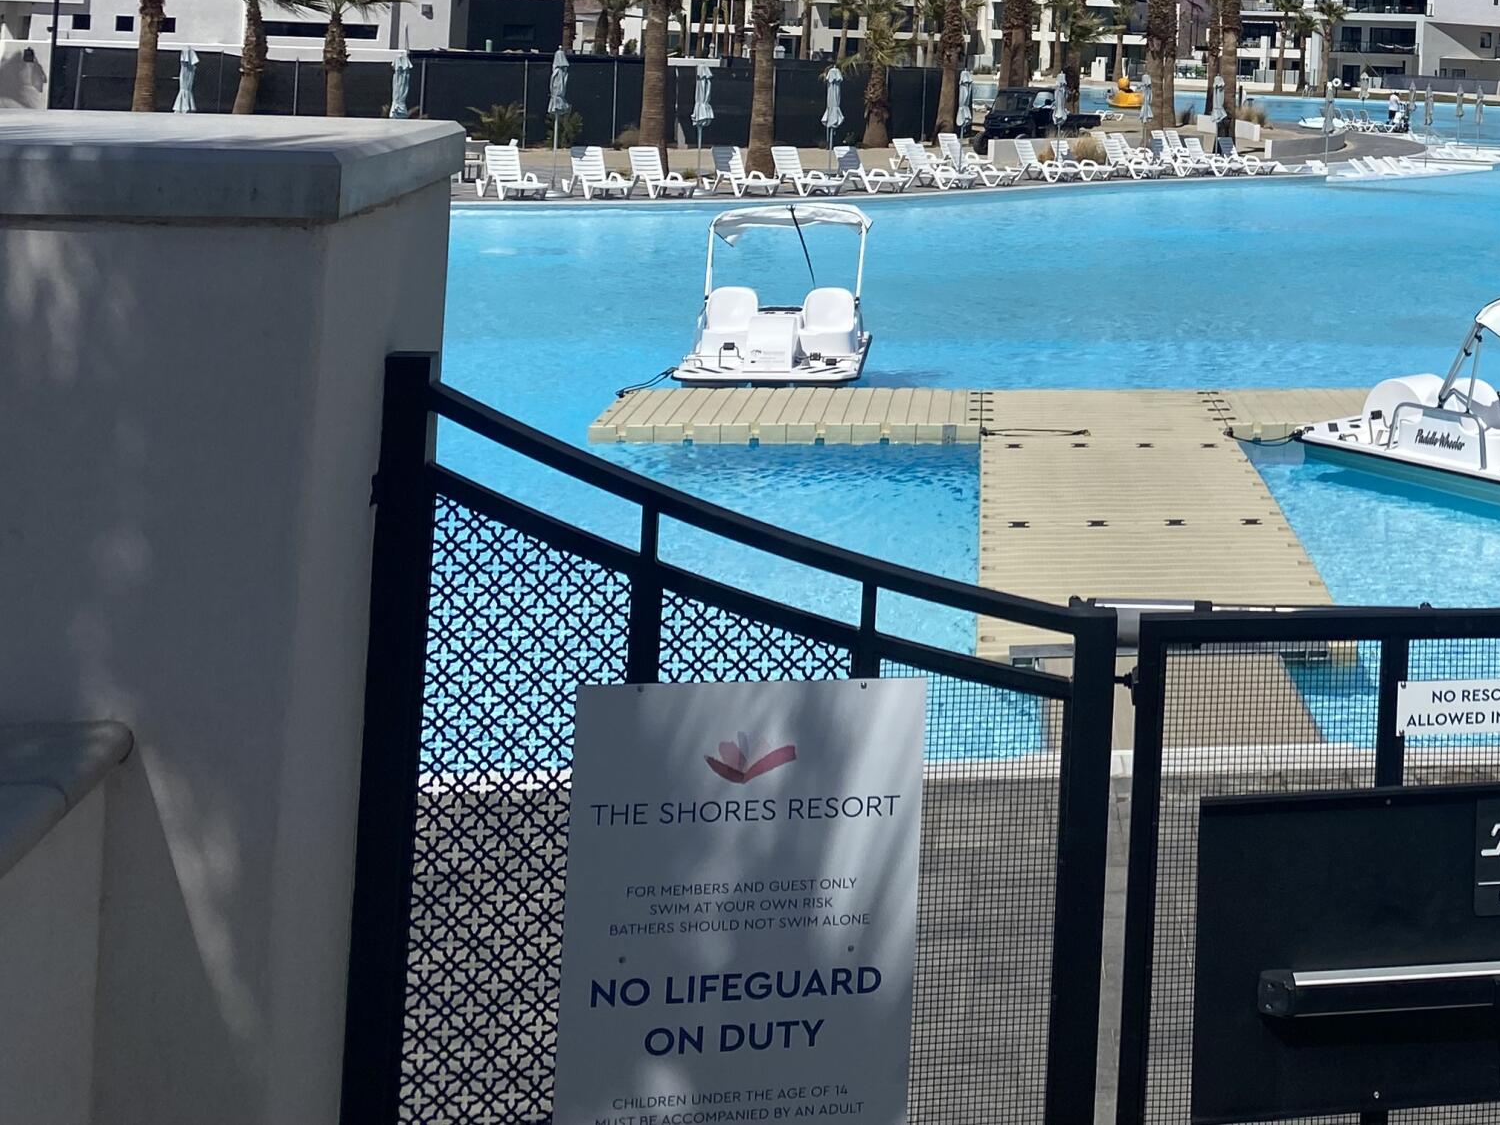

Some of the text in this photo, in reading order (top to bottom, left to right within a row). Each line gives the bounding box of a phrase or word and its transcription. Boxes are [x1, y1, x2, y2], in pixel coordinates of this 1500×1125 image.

[1415, 429, 1465, 451] Paddle Wheeler
[1432, 690, 1456, 703] NO
[1407, 712, 1485, 727] ALLOWED
[591, 795, 900, 826] THE SHORES RESORT
[627, 878, 856, 898] FOR MEMBERS AND GUEST ONLY
[650, 897, 833, 915] SWIM AT YOUR OWN RISK
[610, 914, 869, 936] BATHERS SHOULD NOT SWIM ALONE
[591, 967, 881, 1008] NO LIFEGUARD
[645, 1019, 824, 1056] ON DUTY
[613, 1085, 848, 1110] CHILDREN UNDER THE AGE OF 14
[640, 1115, 657, 1125] BE
[661, 1108, 769, 1125] ACCOMPANIED
[774, 1107, 790, 1118] BY
[795, 1105, 814, 1116] AN
[819, 1102, 864, 1115] ADULT
